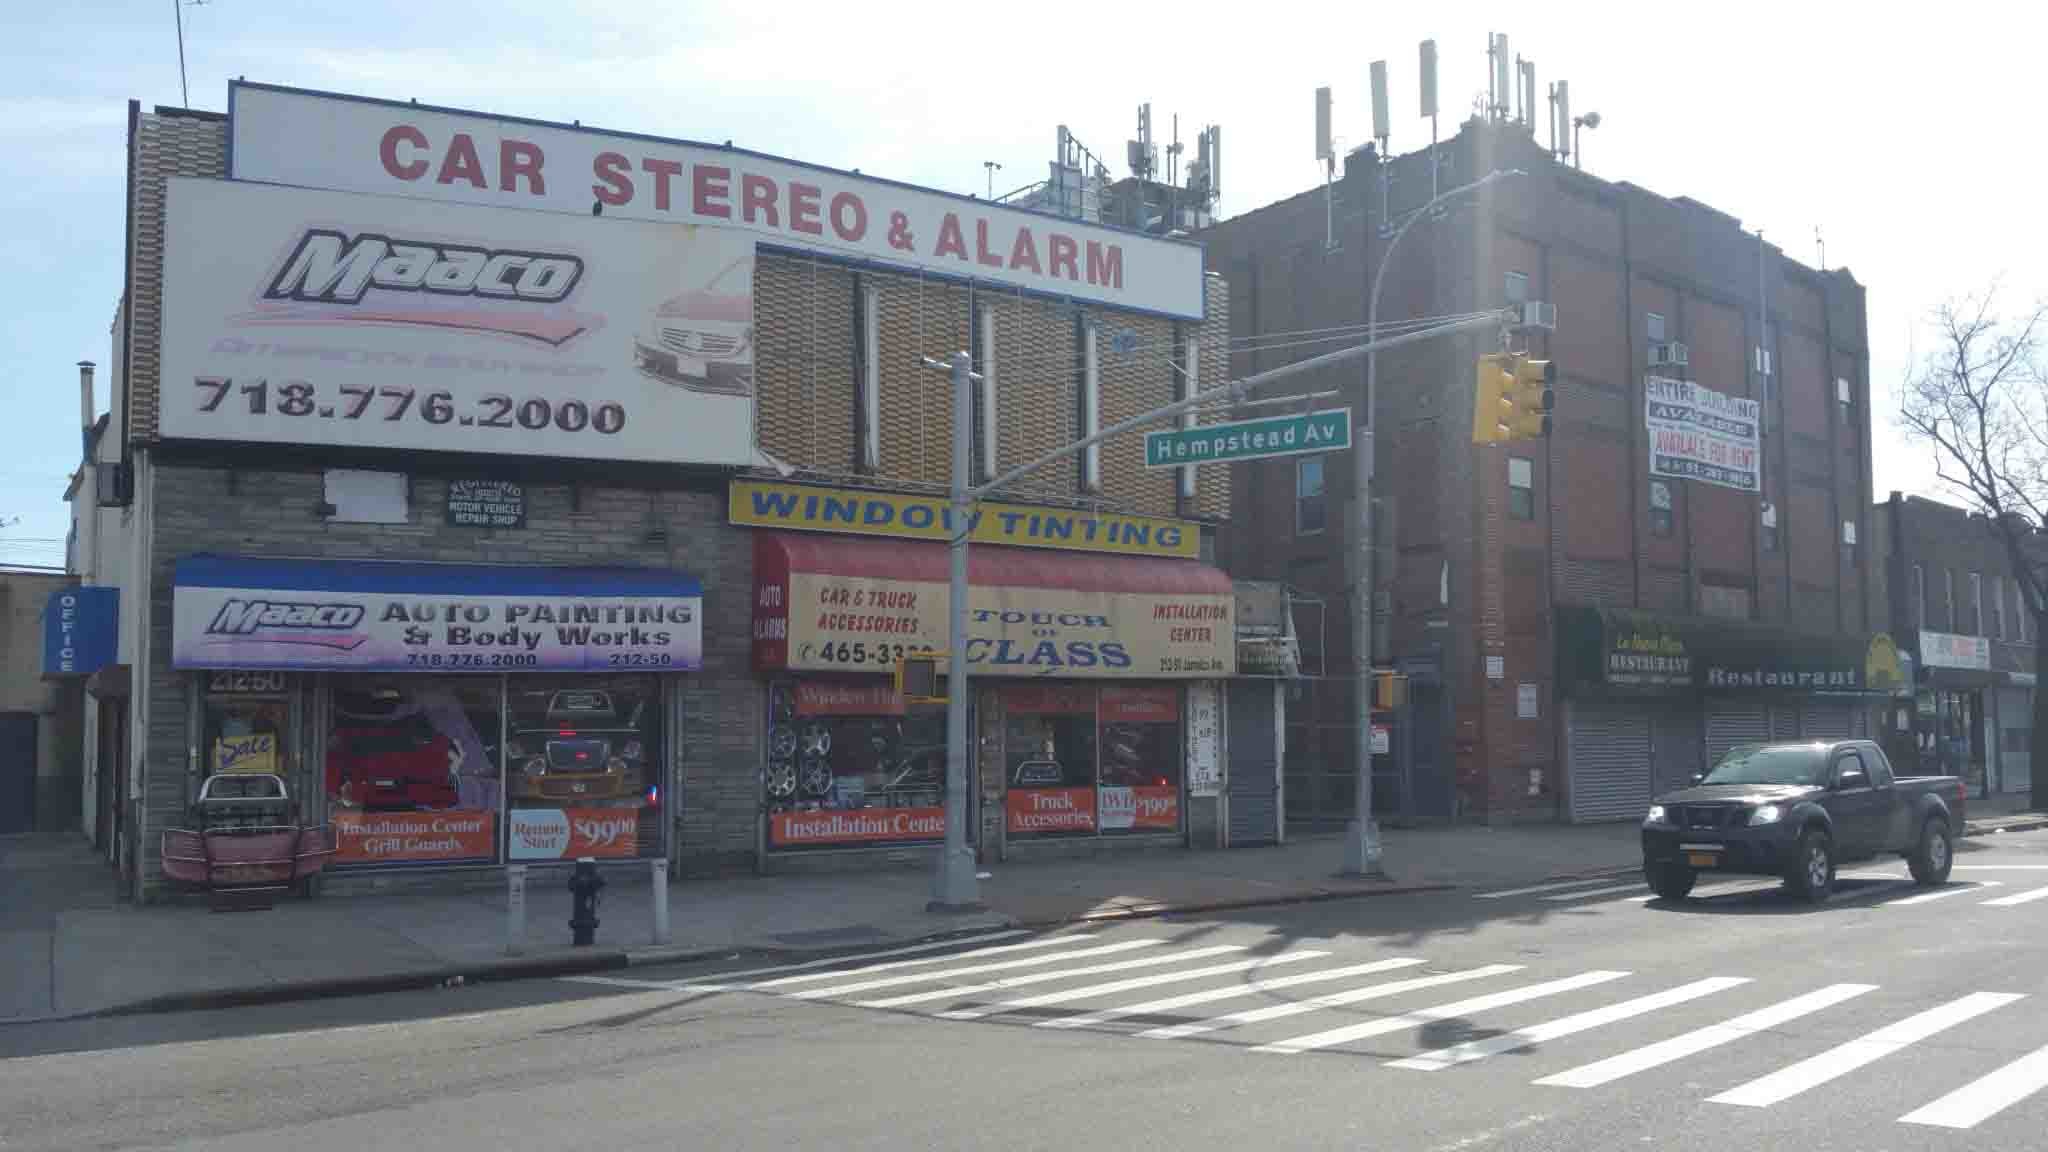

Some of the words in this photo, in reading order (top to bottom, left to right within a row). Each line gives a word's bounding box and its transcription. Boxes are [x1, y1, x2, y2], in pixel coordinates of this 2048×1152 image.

[379, 125, 546, 196] CAR
[591, 151, 868, 243] STEREO
[886, 210, 914, 252] &
[932, 212, 1123, 289] ALARM
[264, 228, 584, 303] Maaco
[193, 375, 626, 434] 718.776.2000
[1157, 425, 1296, 459] Hempstead
[1304, 423, 1335, 443] Av
[751, 491, 983, 531] WINDOW
[997, 512, 1183, 547] TINTING
[821, 588, 849, 607] CAR
[855, 591, 864, 606] &
[868, 592, 917, 610] TRUCK
[204, 600, 366, 635] Maaco
[379, 602, 487, 624] AUTO
[505, 604, 693, 624] PAINTING
[973, 608, 1113, 627] TOUCH
[1152, 603, 1228, 620] INSTALLATION
[60, 596, 76, 672] OFFICE
[818, 613, 918, 634] ACCESSORIES
[403, 626, 431, 646] &
[458, 626, 541, 651] Body
[557, 626, 672, 647] Works
[1170, 627, 1212, 643] CENTER
[964, 638, 1132, 668] CLASS
[1708, 668, 1857, 686] Restaurant
[1028, 790, 1073, 811] Truck
[343, 819, 426, 835] Installation
[432, 817, 480, 834] Center
[784, 815, 888, 837] Installation
[895, 814, 946, 832] Cente
[1012, 811, 1094, 826] Accessories
